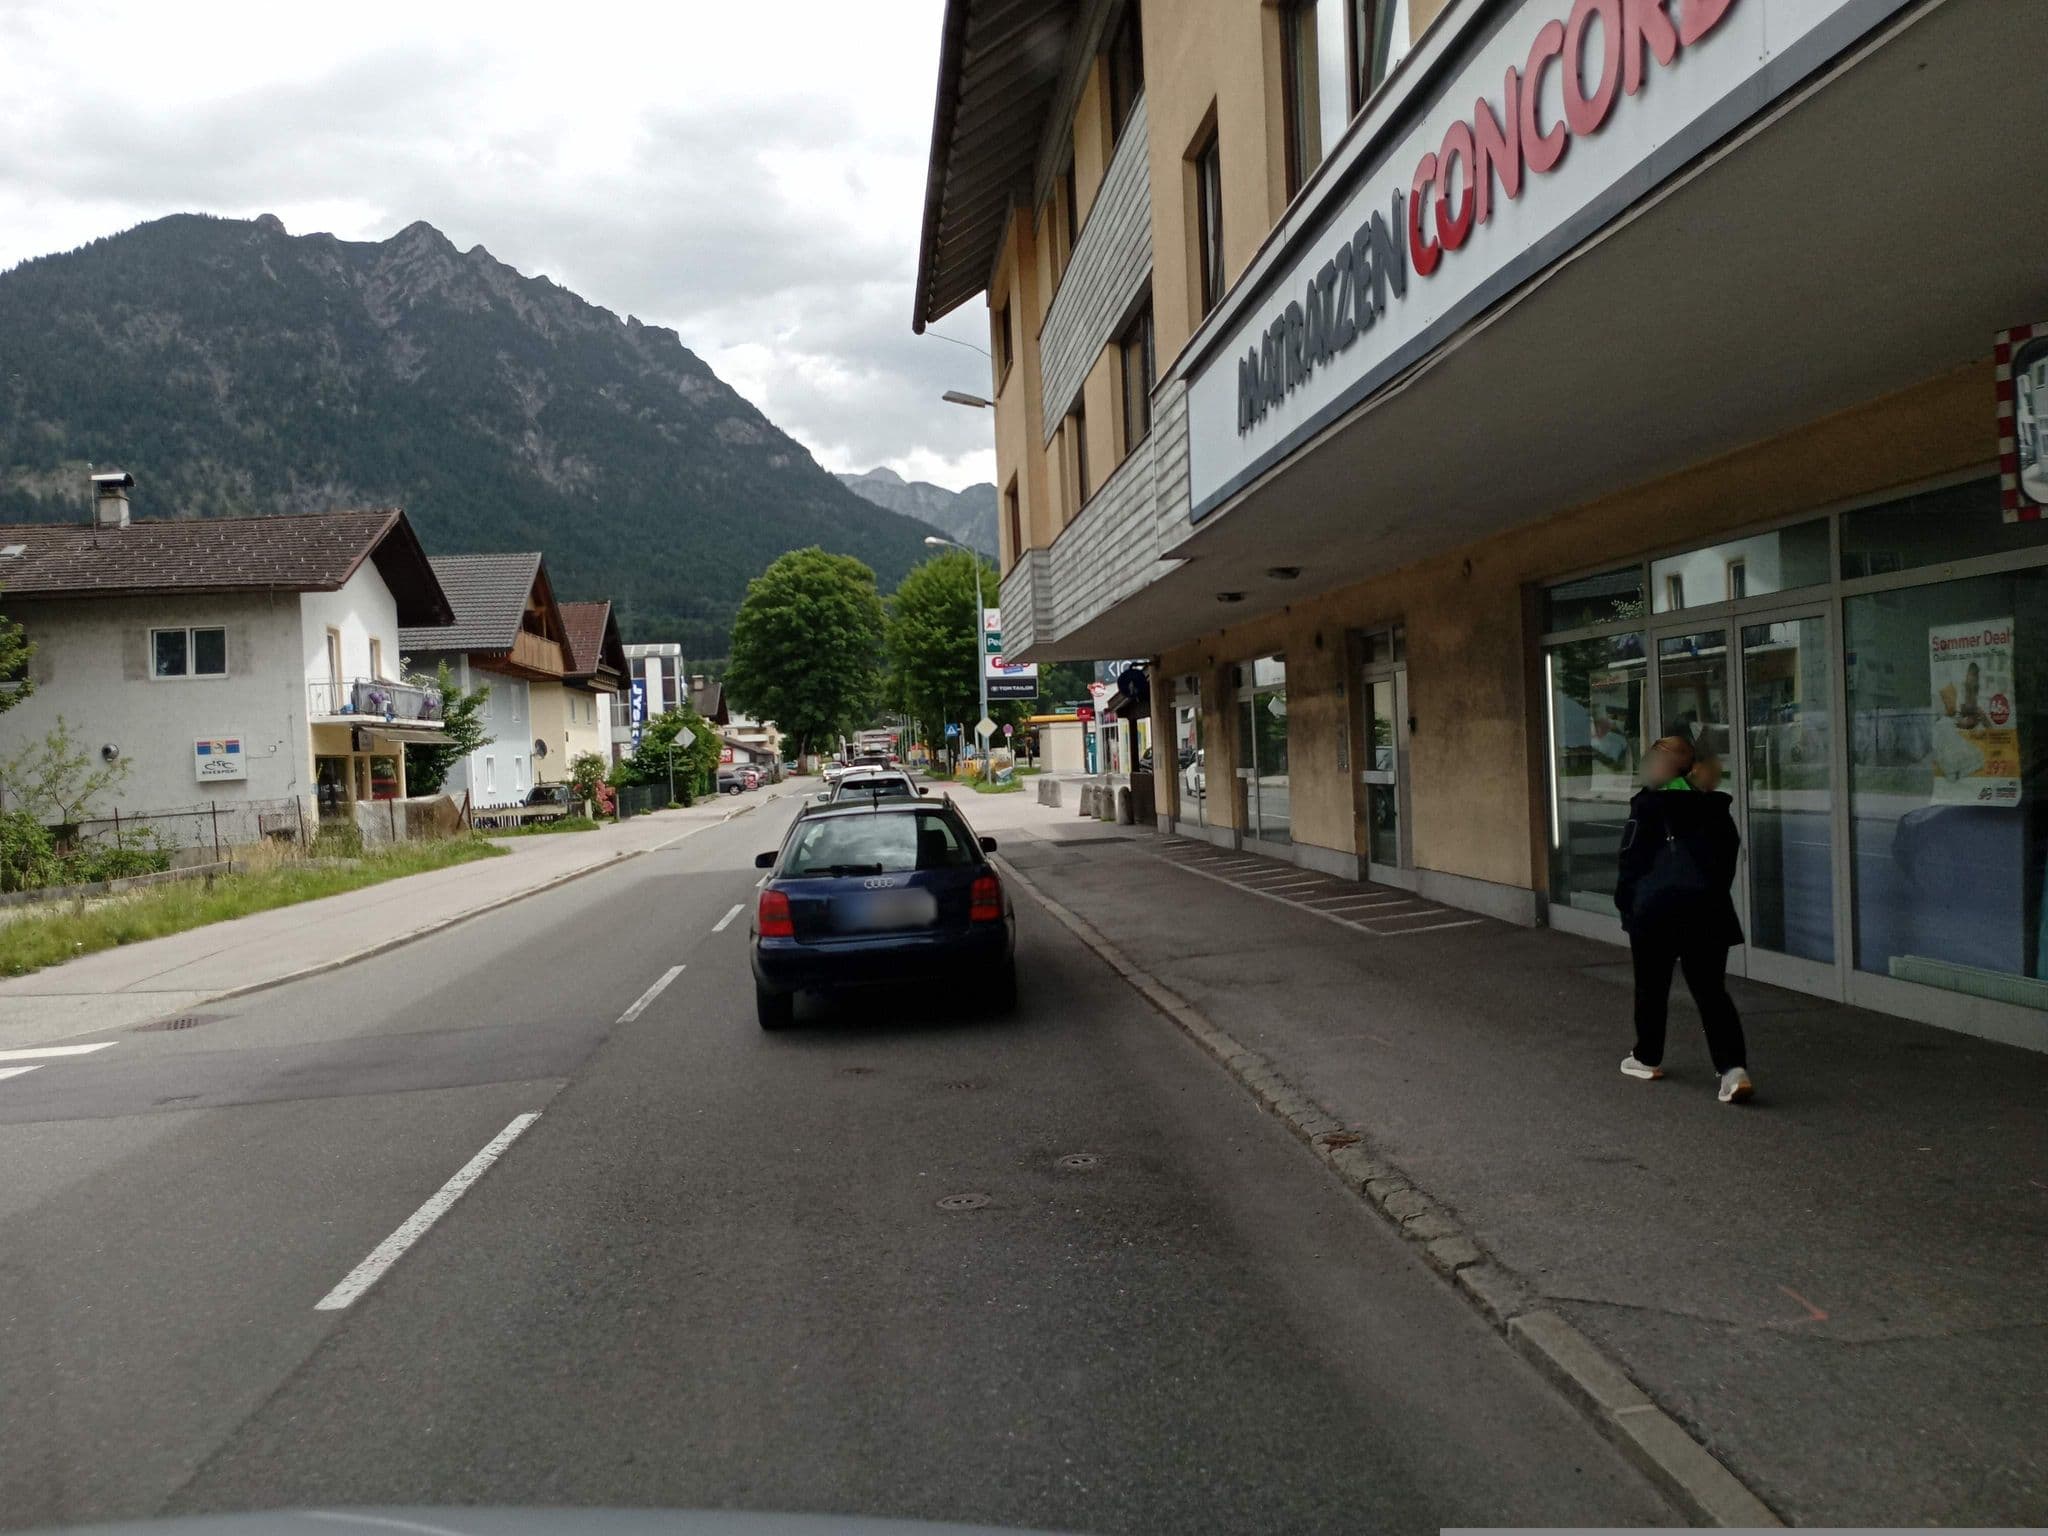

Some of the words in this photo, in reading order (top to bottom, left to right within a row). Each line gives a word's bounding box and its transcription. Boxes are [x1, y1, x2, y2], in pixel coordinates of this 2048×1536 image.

[1238, 187, 1405, 437] MATRATZEN
[1408, 0, 1732, 277] CONCOR
[1932, 635, 1981, 652] Sommer
[1984, 626, 2010, 645] Deal
[632, 683, 643, 737] JYSK
